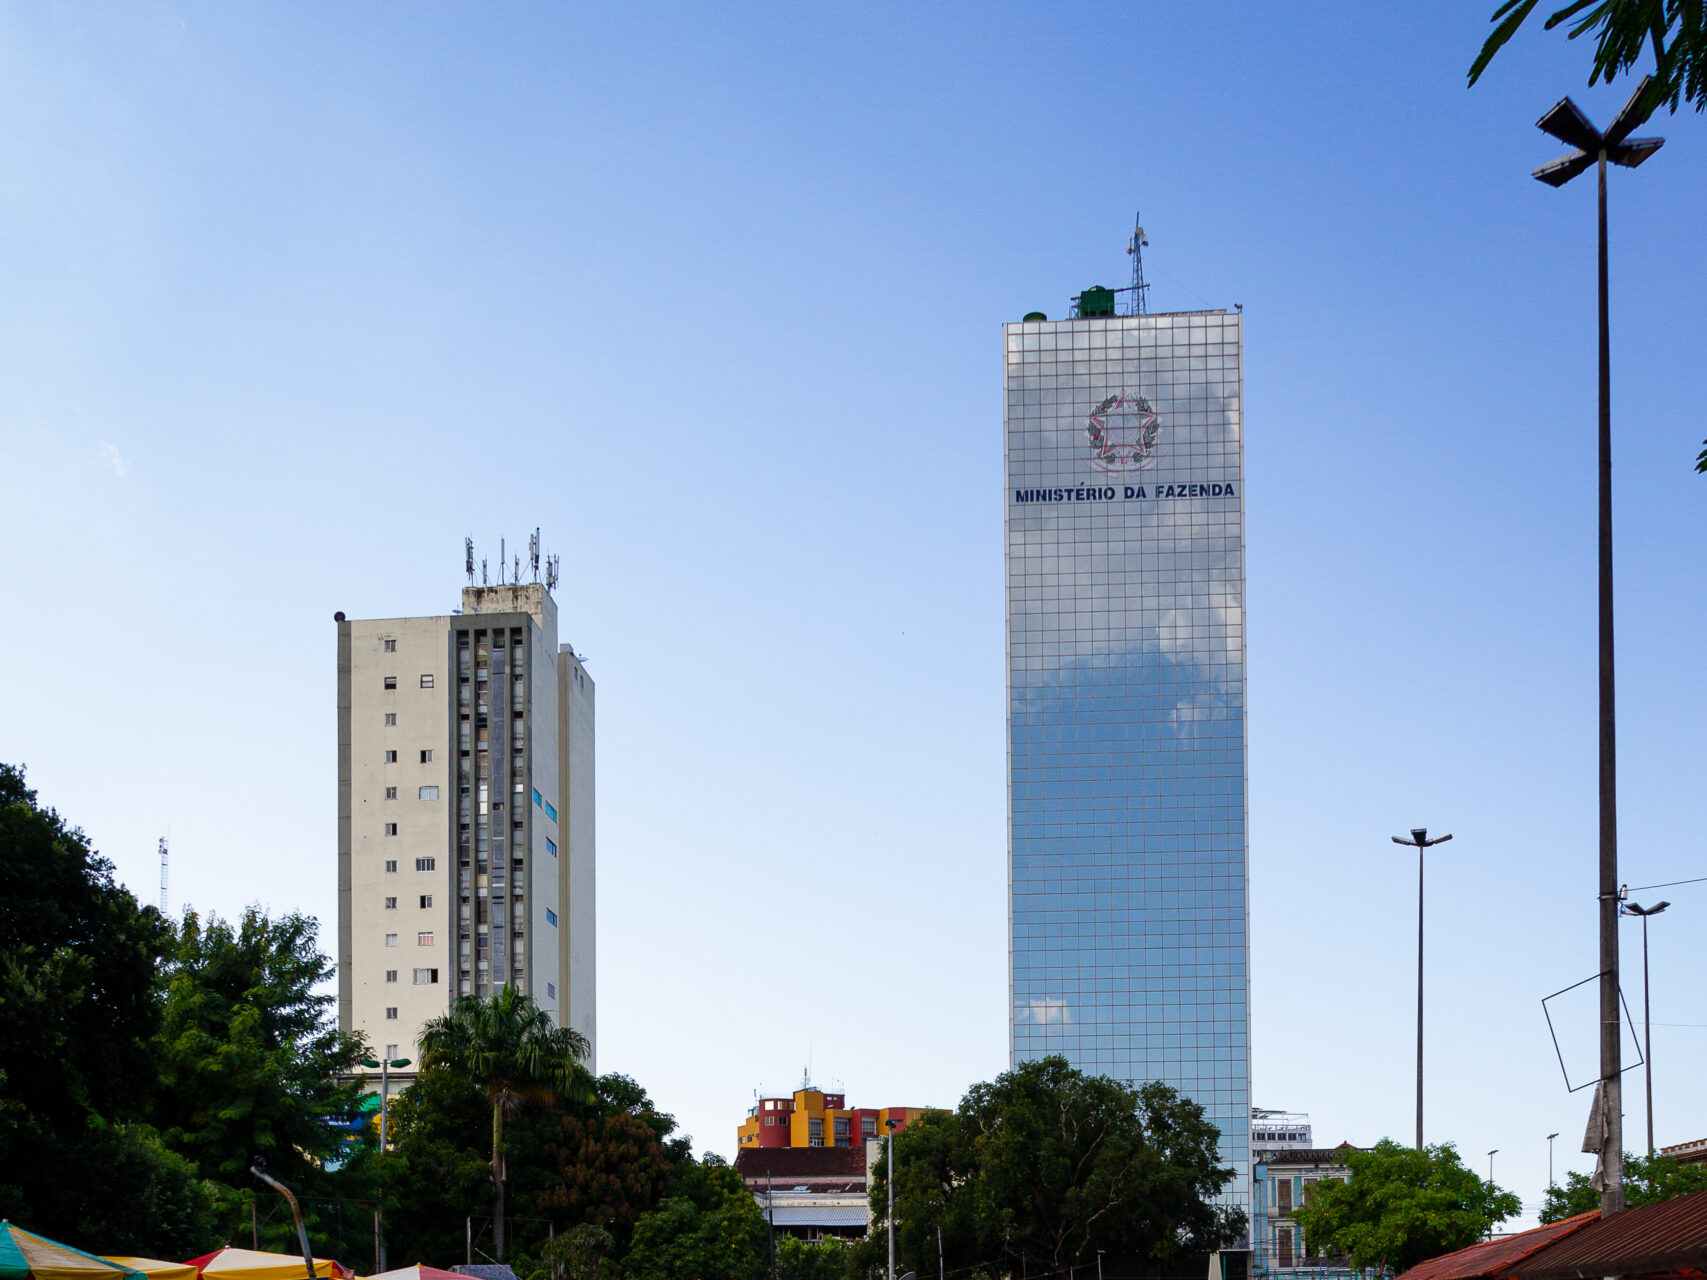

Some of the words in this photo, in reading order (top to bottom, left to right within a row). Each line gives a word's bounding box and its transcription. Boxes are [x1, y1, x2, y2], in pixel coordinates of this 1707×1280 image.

[1015, 482, 1116, 503] MINISTÉRIO
[1124, 484, 1147, 500] DA
[1155, 483, 1235, 499] FAZENDA
